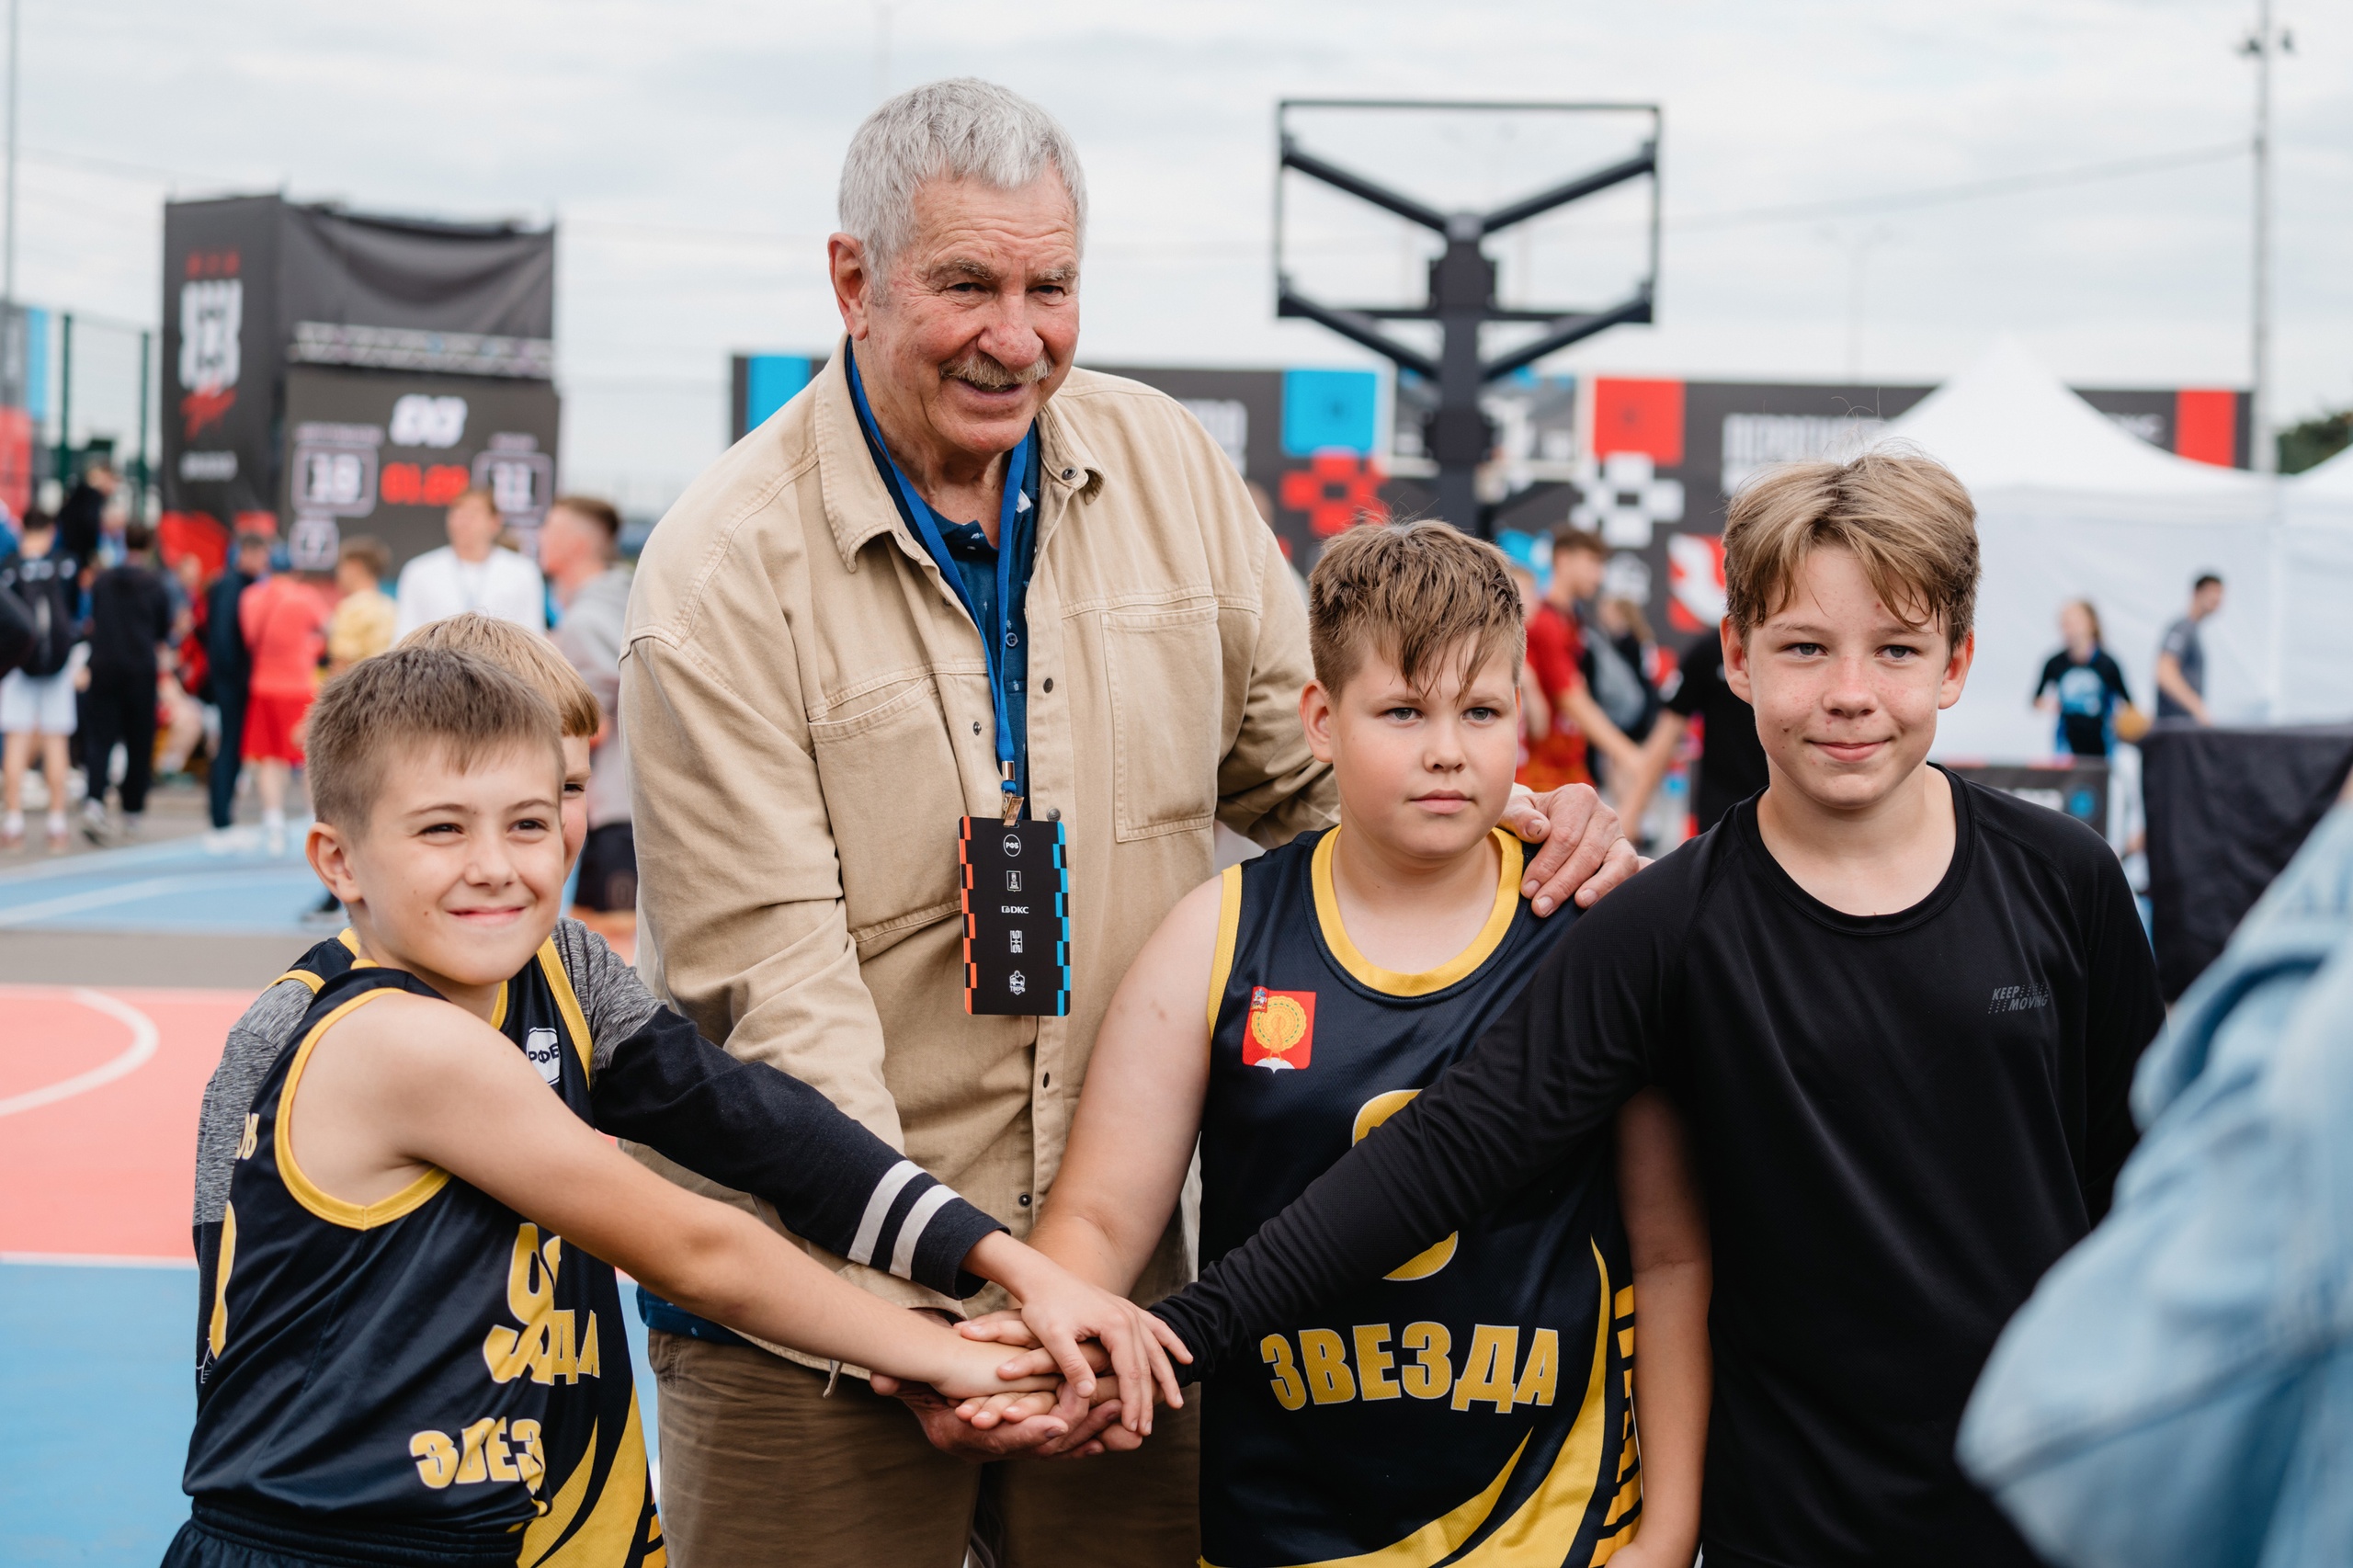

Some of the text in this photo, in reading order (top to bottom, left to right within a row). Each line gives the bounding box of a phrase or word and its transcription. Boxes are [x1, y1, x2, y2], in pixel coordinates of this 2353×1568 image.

[1992, 985, 2020, 1001] KEEP
[2008, 994, 2049, 1011] MOVNG
[1260, 1321, 1559, 1414] ЗВЕЗДА
